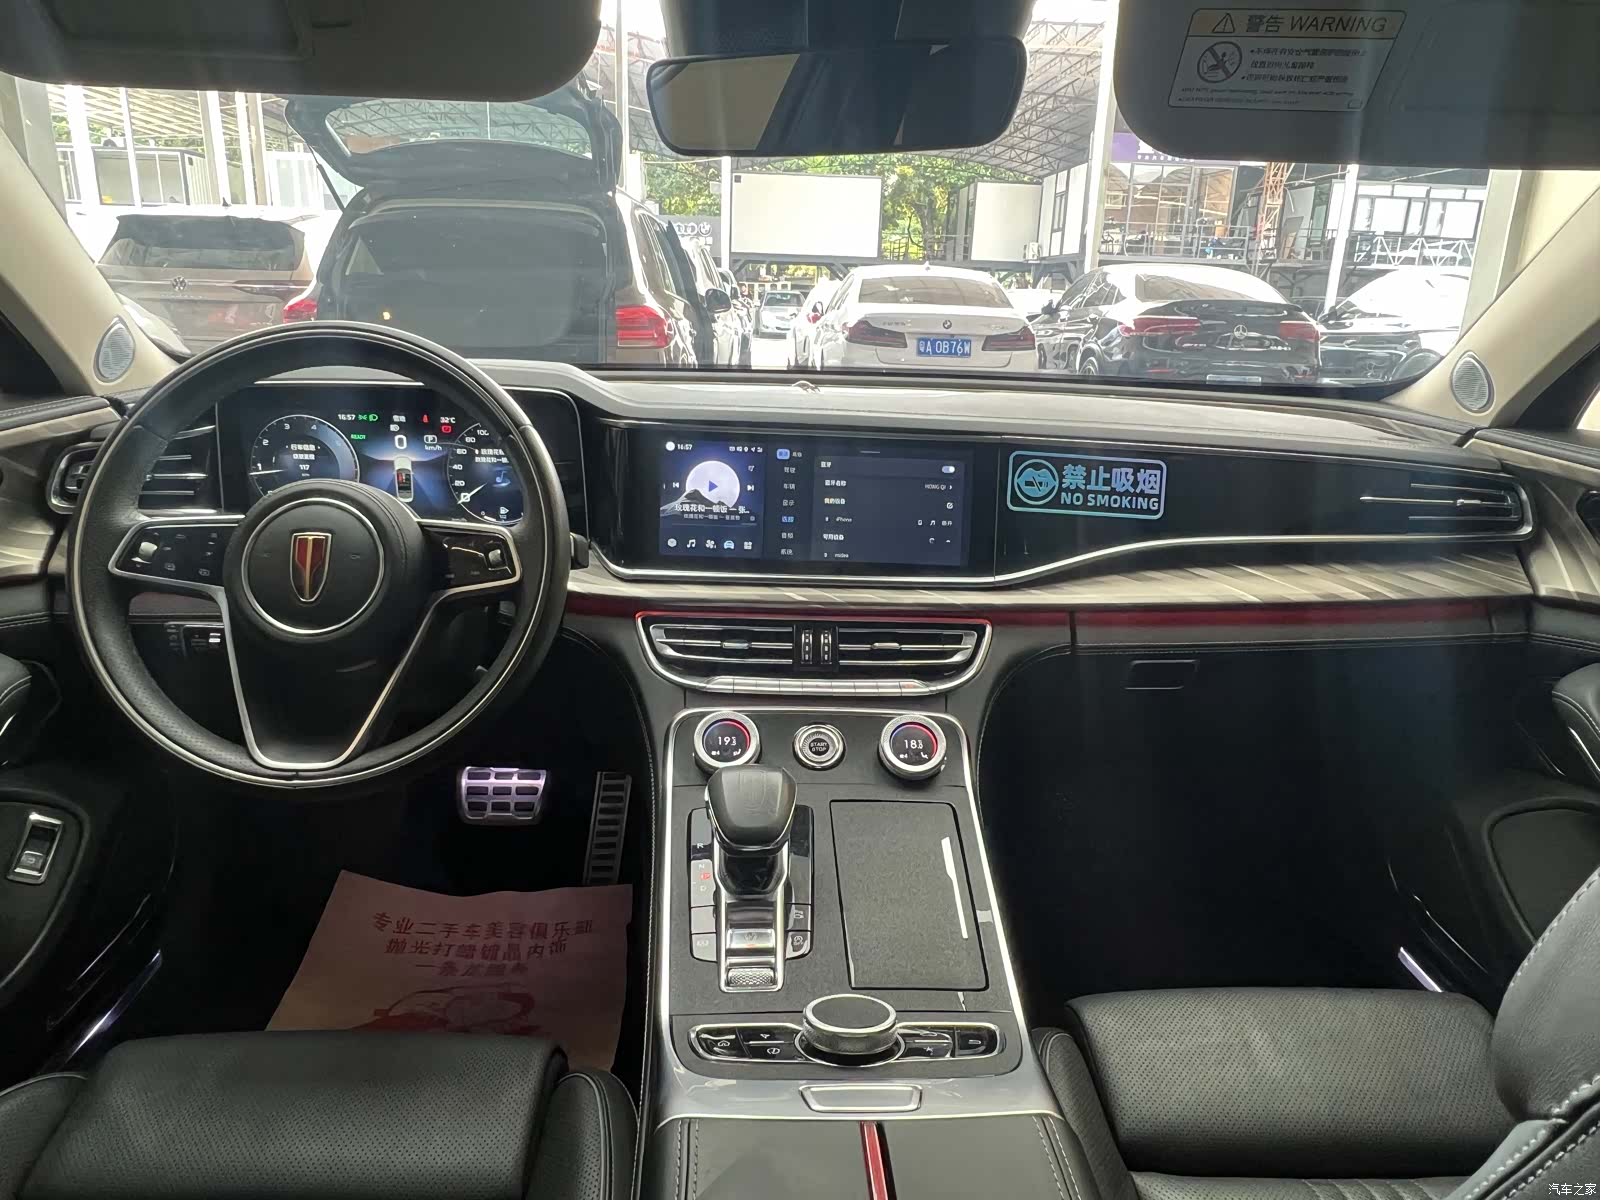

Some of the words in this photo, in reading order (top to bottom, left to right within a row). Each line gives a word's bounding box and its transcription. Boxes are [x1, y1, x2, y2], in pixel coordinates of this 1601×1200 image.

[1247, 14, 1284, 33] 警告
[1290, 16, 1388, 33] WARNING
[1062, 464, 1161, 494] 禁止吸烟
[1060, 492, 1084, 505] NO
[1087, 494, 1159, 510] SMOKING
